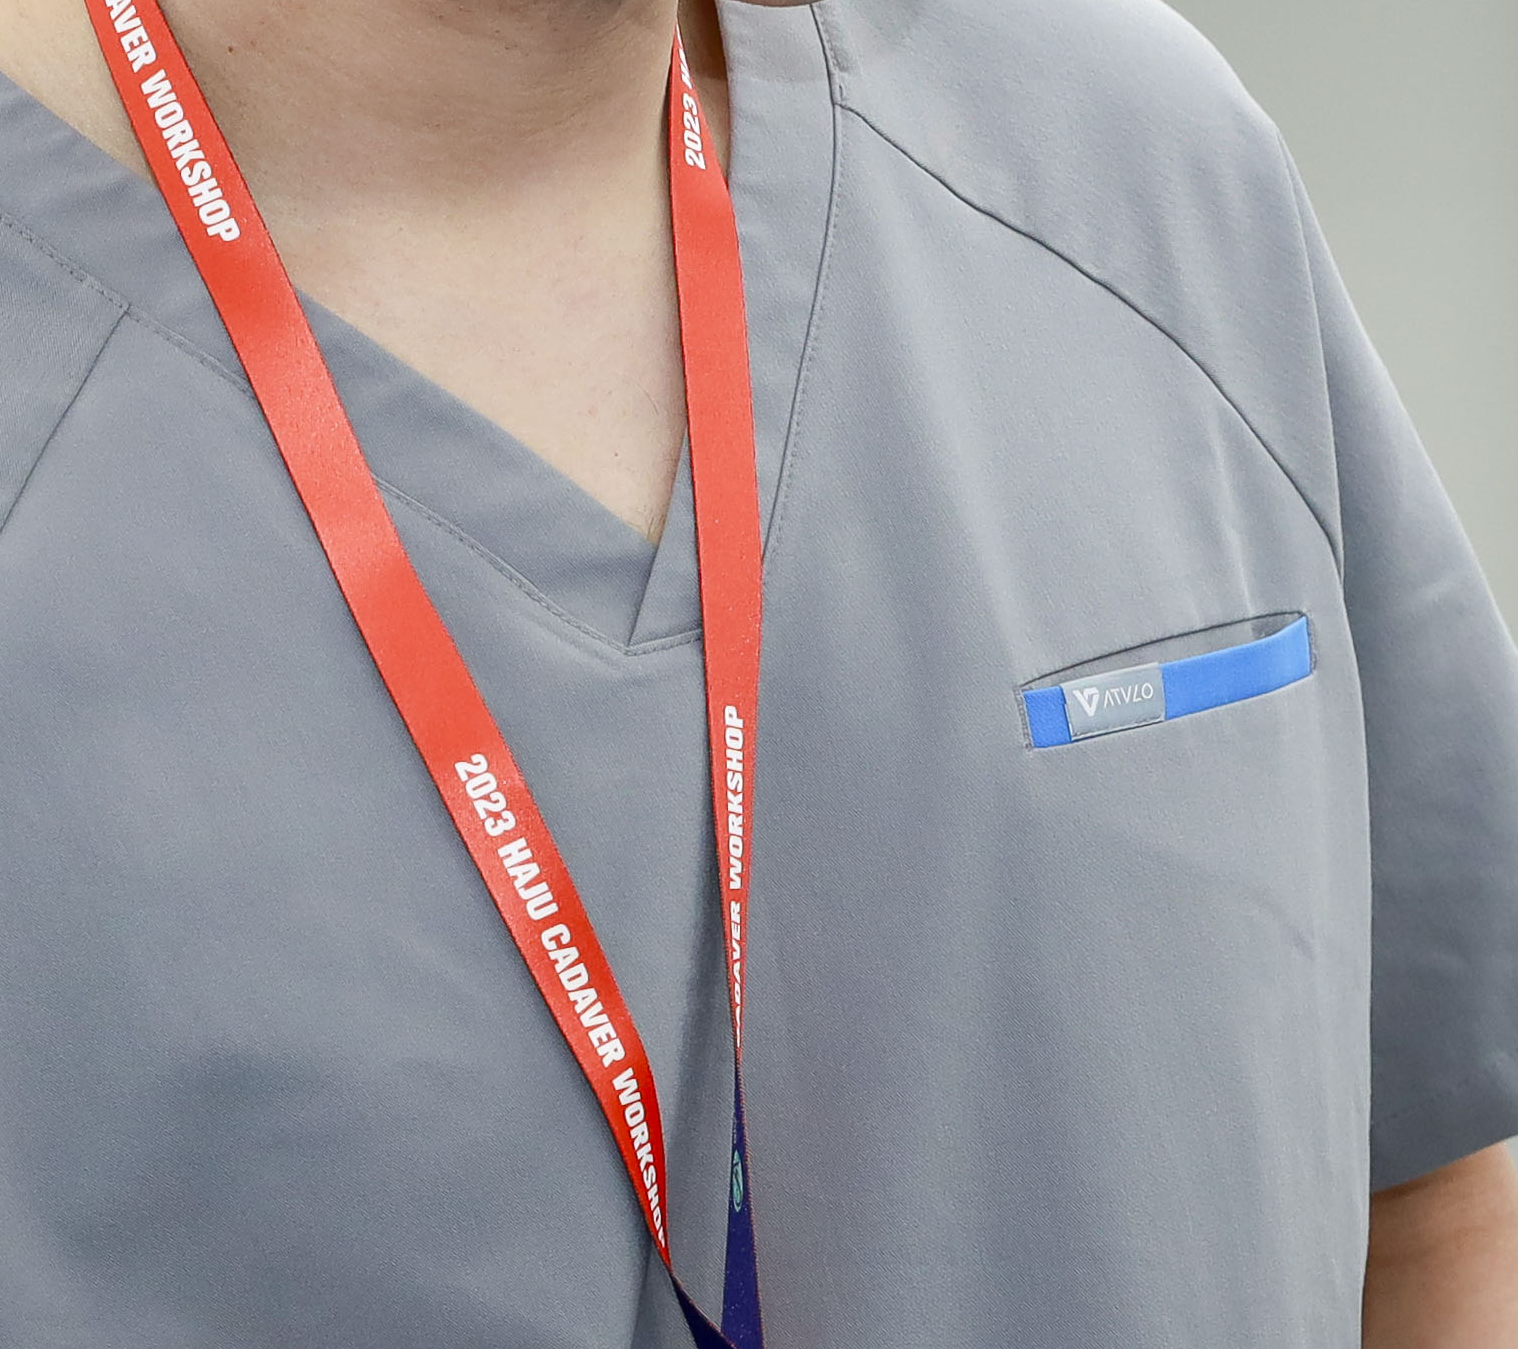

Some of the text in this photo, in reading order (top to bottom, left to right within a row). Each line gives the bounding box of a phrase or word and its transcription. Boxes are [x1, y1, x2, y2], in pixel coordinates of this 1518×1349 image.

[141, 68, 242, 242] WORKSHOP
[682, 92, 706, 170] 2023
[724, 705, 744, 890] WORKSHOP
[454, 753, 516, 837] 2023
[497, 837, 559, 921] HAJU
[540, 923, 625, 1068] CADAVER
